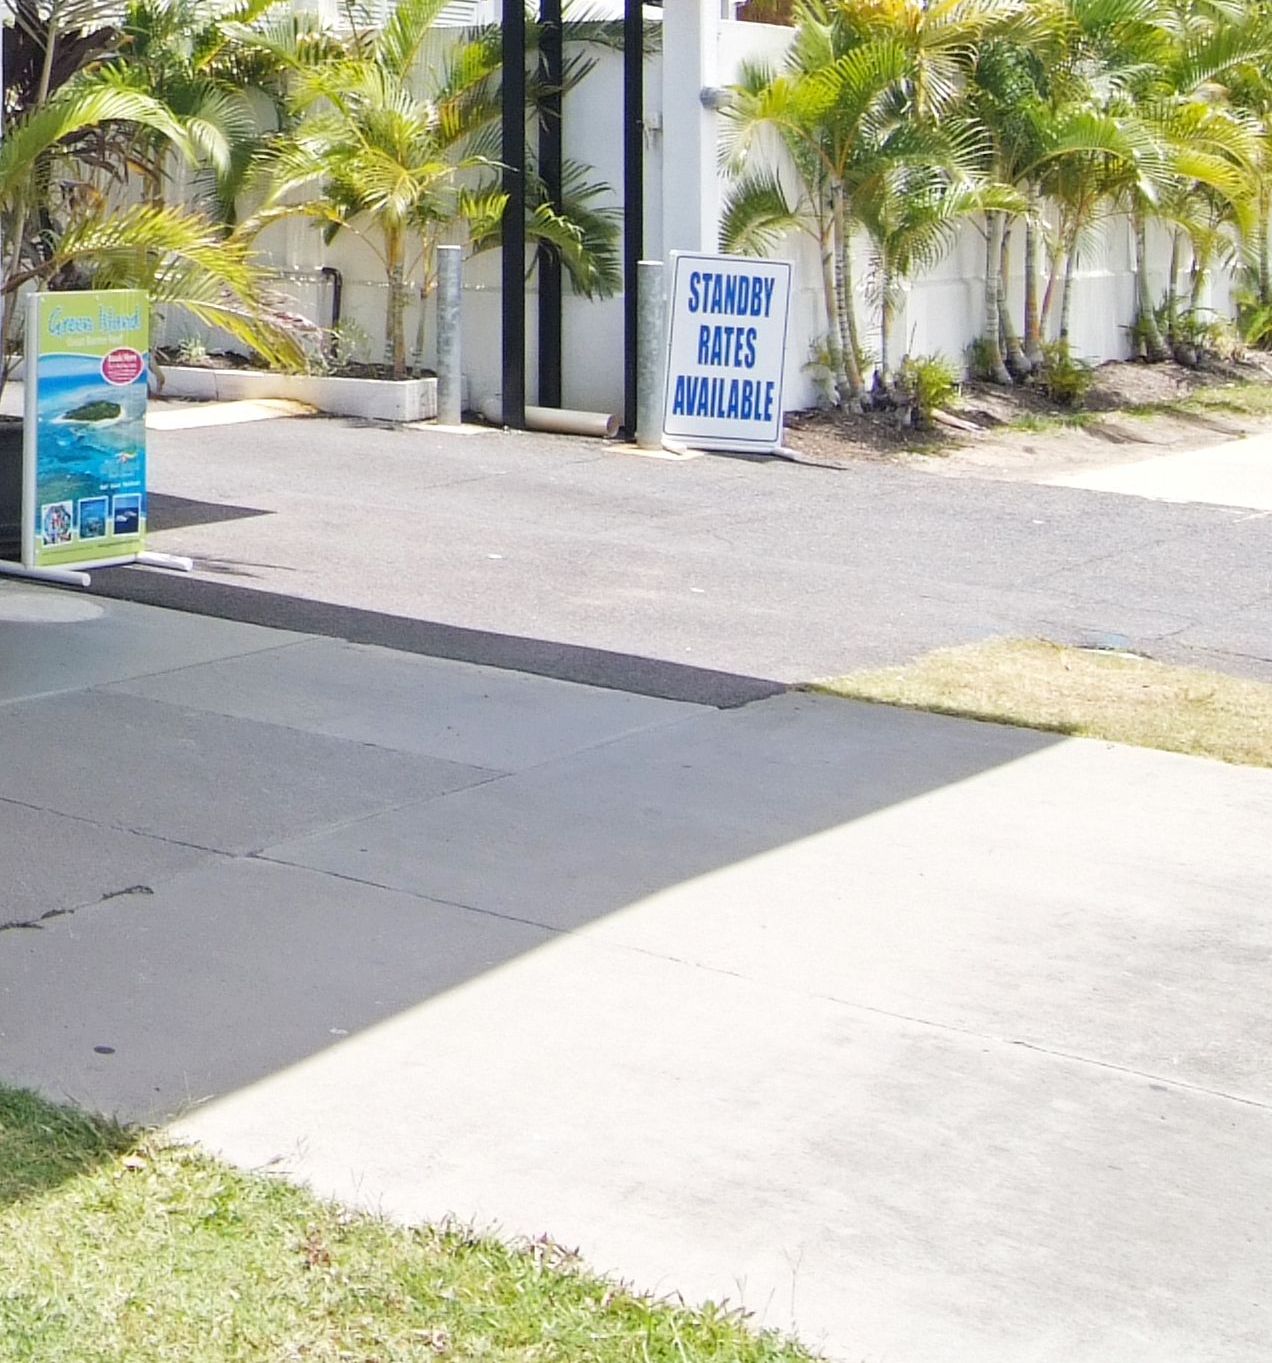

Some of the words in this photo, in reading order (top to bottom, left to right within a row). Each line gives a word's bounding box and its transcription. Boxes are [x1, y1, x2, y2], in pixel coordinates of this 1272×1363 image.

[688, 270, 775, 318] STANDBY
[698, 325, 757, 368] RATES
[672, 375, 775, 421] AVAILABLE
